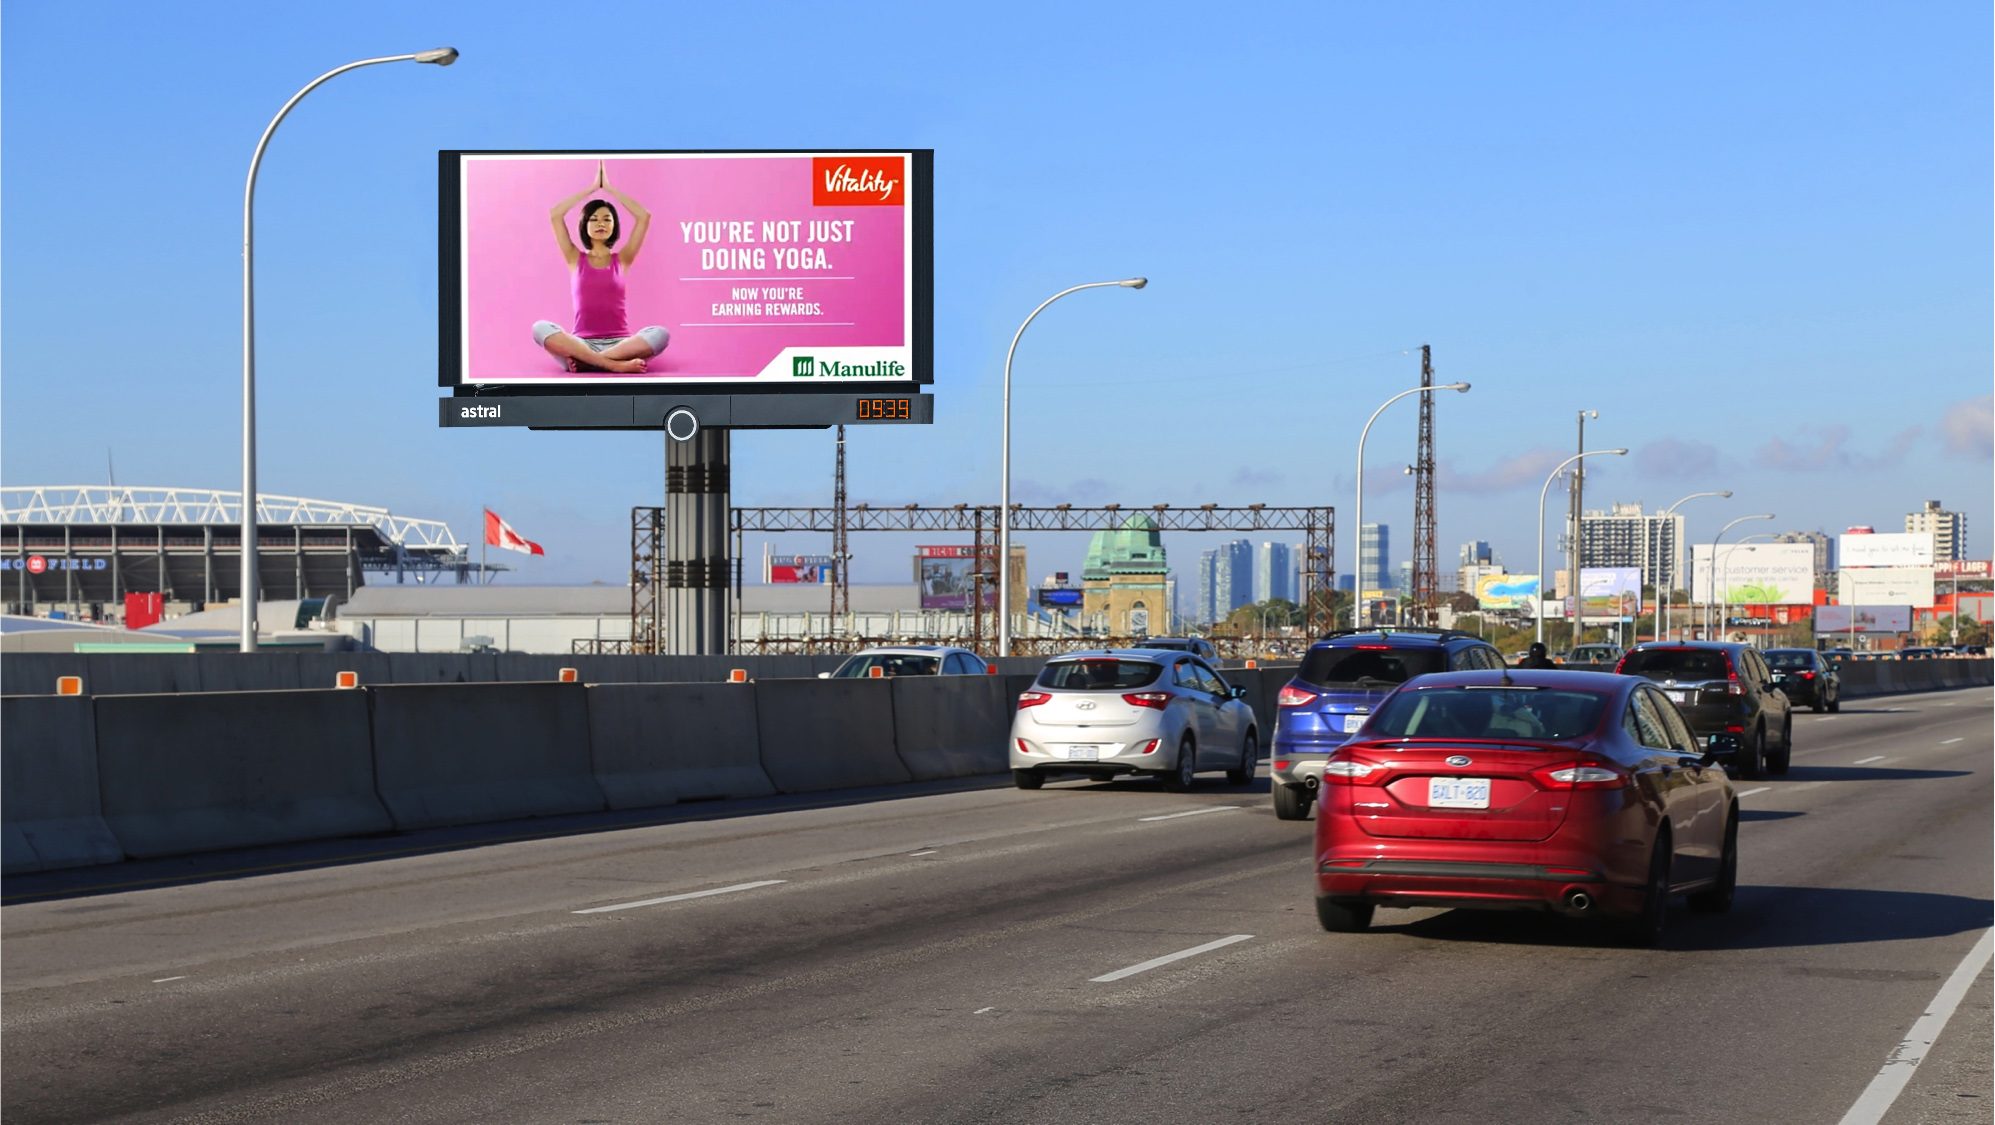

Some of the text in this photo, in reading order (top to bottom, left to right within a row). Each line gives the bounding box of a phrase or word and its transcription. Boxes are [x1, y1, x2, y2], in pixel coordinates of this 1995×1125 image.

[680, 220, 855, 243] YOU'RE NOT JUST
[702, 248, 833, 270] DOING YOGA.
[732, 287, 803, 300] NOW YOU'RE
[712, 303, 824, 316] EARNING REWARDS.
[819, 360, 905, 377] Manulife
[461, 404, 501, 418] astral
[860, 399, 909, 418] 09:39
[48, 559, 106, 570] FIELD
[1771, 565, 1808, 574] service
[1961, 561, 1988, 572] LAGER
